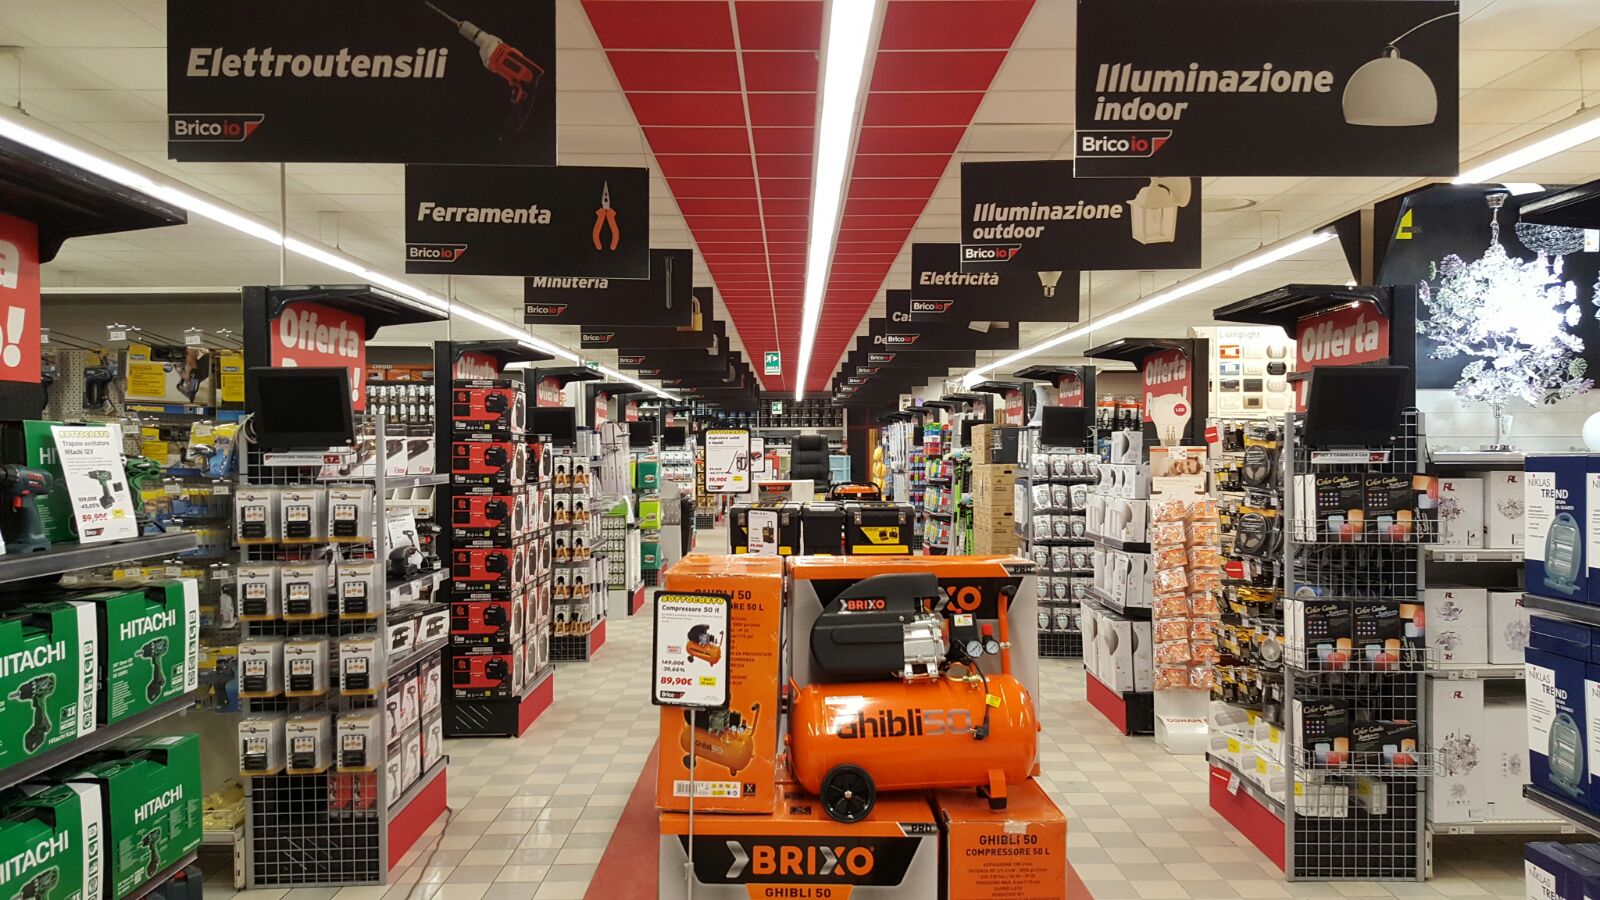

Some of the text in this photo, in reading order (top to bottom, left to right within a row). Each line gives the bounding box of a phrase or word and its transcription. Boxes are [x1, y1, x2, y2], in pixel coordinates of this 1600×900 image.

[186, 47, 449, 79] Elettroutensili
[1095, 62, 1334, 93] Illuminazione
[1094, 95, 1188, 121] indoor
[417, 202, 551, 225] Ferramenta
[973, 200, 1123, 222] Illuminazione
[972, 222, 1044, 240] outdoor
[532, 276, 609, 289] Minuteria
[279, 307, 359, 359] Offerta
[1301, 312, 1379, 363] Offerta
[1145, 353, 1187, 386] Offerta
[1528, 478, 1551, 487] NIKLAS
[1541, 488, 1568, 499] TREND
[82, 512, 108, 522] 59,90€
[1014, 565, 1031, 574] PRO
[661, 595, 725, 604] SOTTOCOSTO
[738, 590, 751, 599] 50
[661, 605, 701, 613] Compressore
[847, 599, 885, 610] BRIXO
[120, 609, 176, 641] HITACHI
[660, 676, 693, 686] 89,90€
[1528, 671, 1551, 684] NIKLAS
[1541, 683, 1568, 700] TREND
[134, 784, 183, 825] HITACHI
[911, 823, 932, 833] PRO
[979, 834, 1038, 845] GHIBLI 50
[966, 847, 1051, 857] COMPRESSORE 50 L
[752, 845, 874, 876] BRIXO
[765, 887, 831, 898] GHIBLI 50
